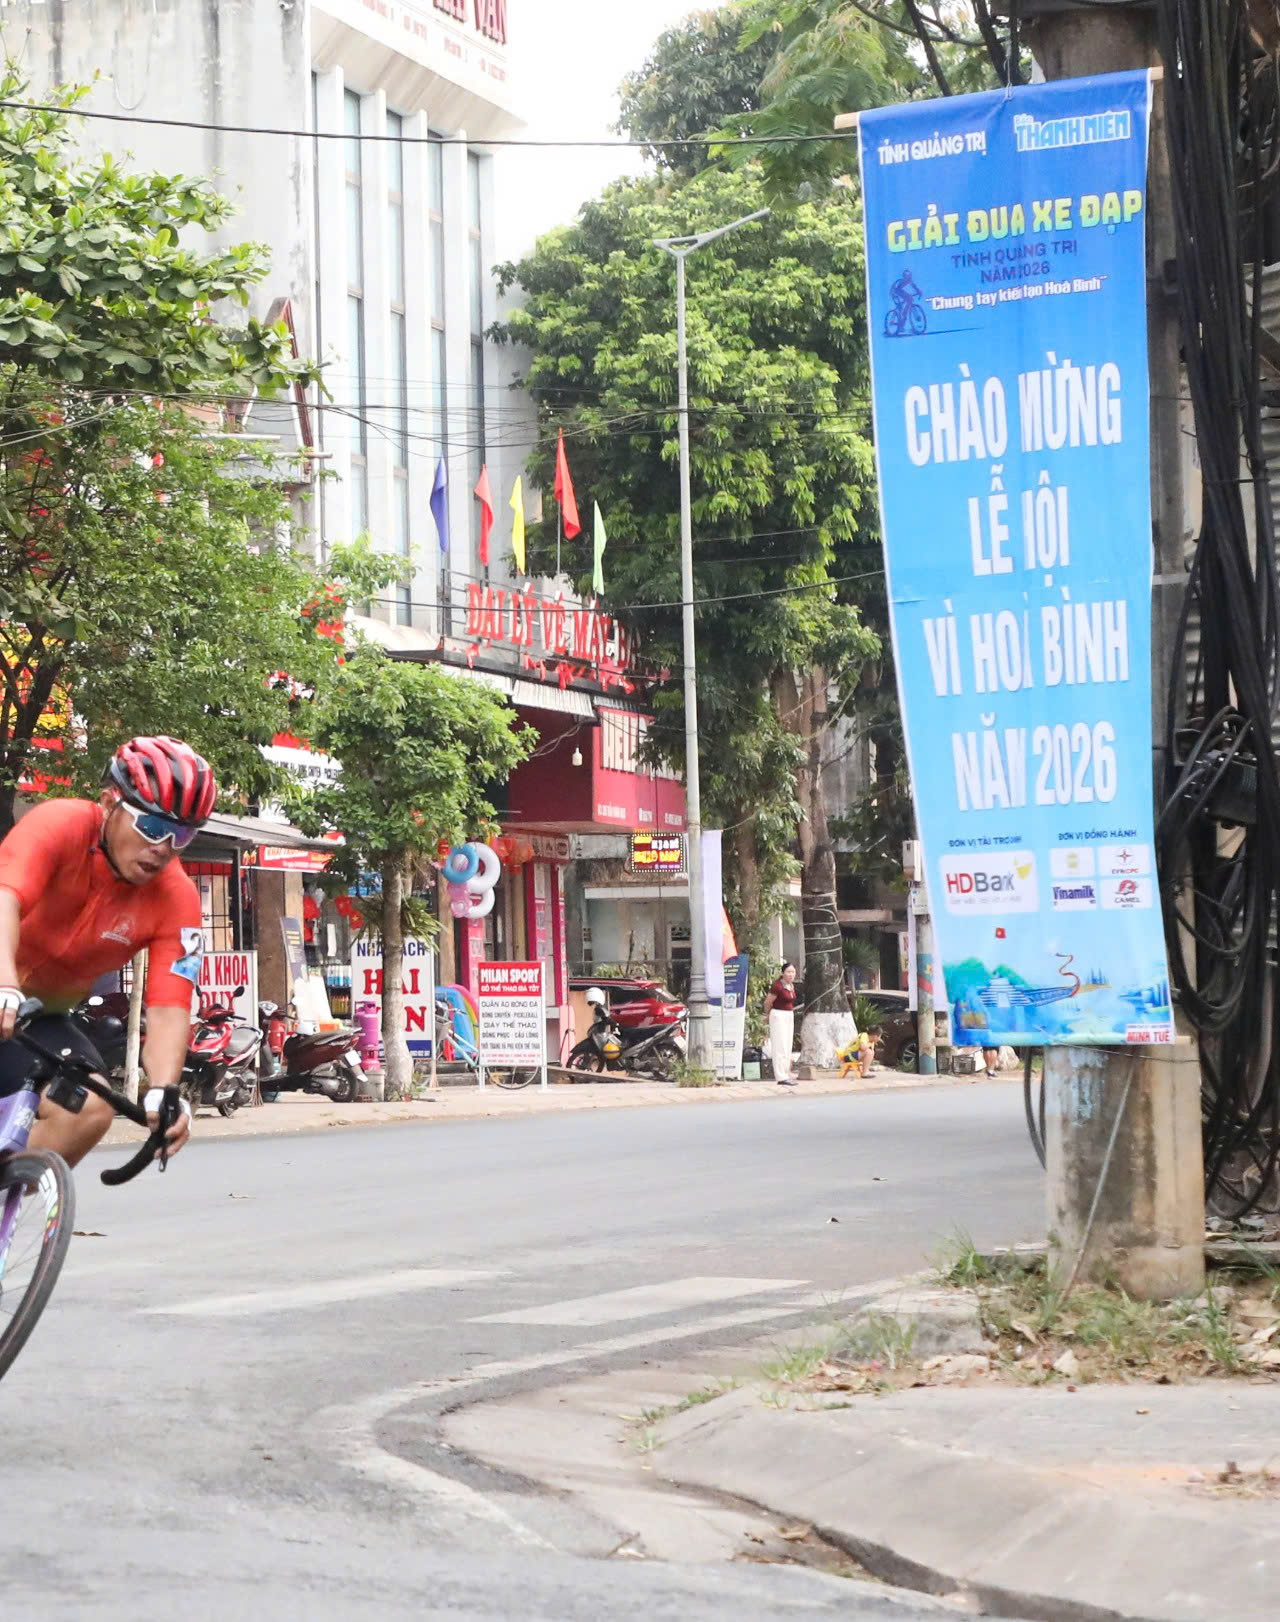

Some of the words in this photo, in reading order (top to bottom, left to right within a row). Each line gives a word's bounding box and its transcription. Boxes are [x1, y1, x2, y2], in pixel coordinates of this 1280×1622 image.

[965, 130, 987, 156] TRỊ
[887, 203, 960, 254] GIẢI
[1032, 197, 1074, 234] XE
[1079, 189, 1144, 236] ĐẠP
[1019, 260, 1051, 278] 026
[976, 290, 998, 307] tay
[1023, 281, 1043, 300] tạo
[904, 363, 1008, 467] CHÀO
[968, 463, 1013, 577] LỄ
[923, 598, 962, 697] VÌ
[1041, 586, 1129, 687] BÌNH
[951, 712, 1026, 811] NĂM
[1032, 721, 1117, 806] 2026
[215, 954, 249, 987] KHOA
[363, 968, 421, 995] HI
[480, 968, 509, 983] MILAN
[510, 968, 540, 984] SPORT
